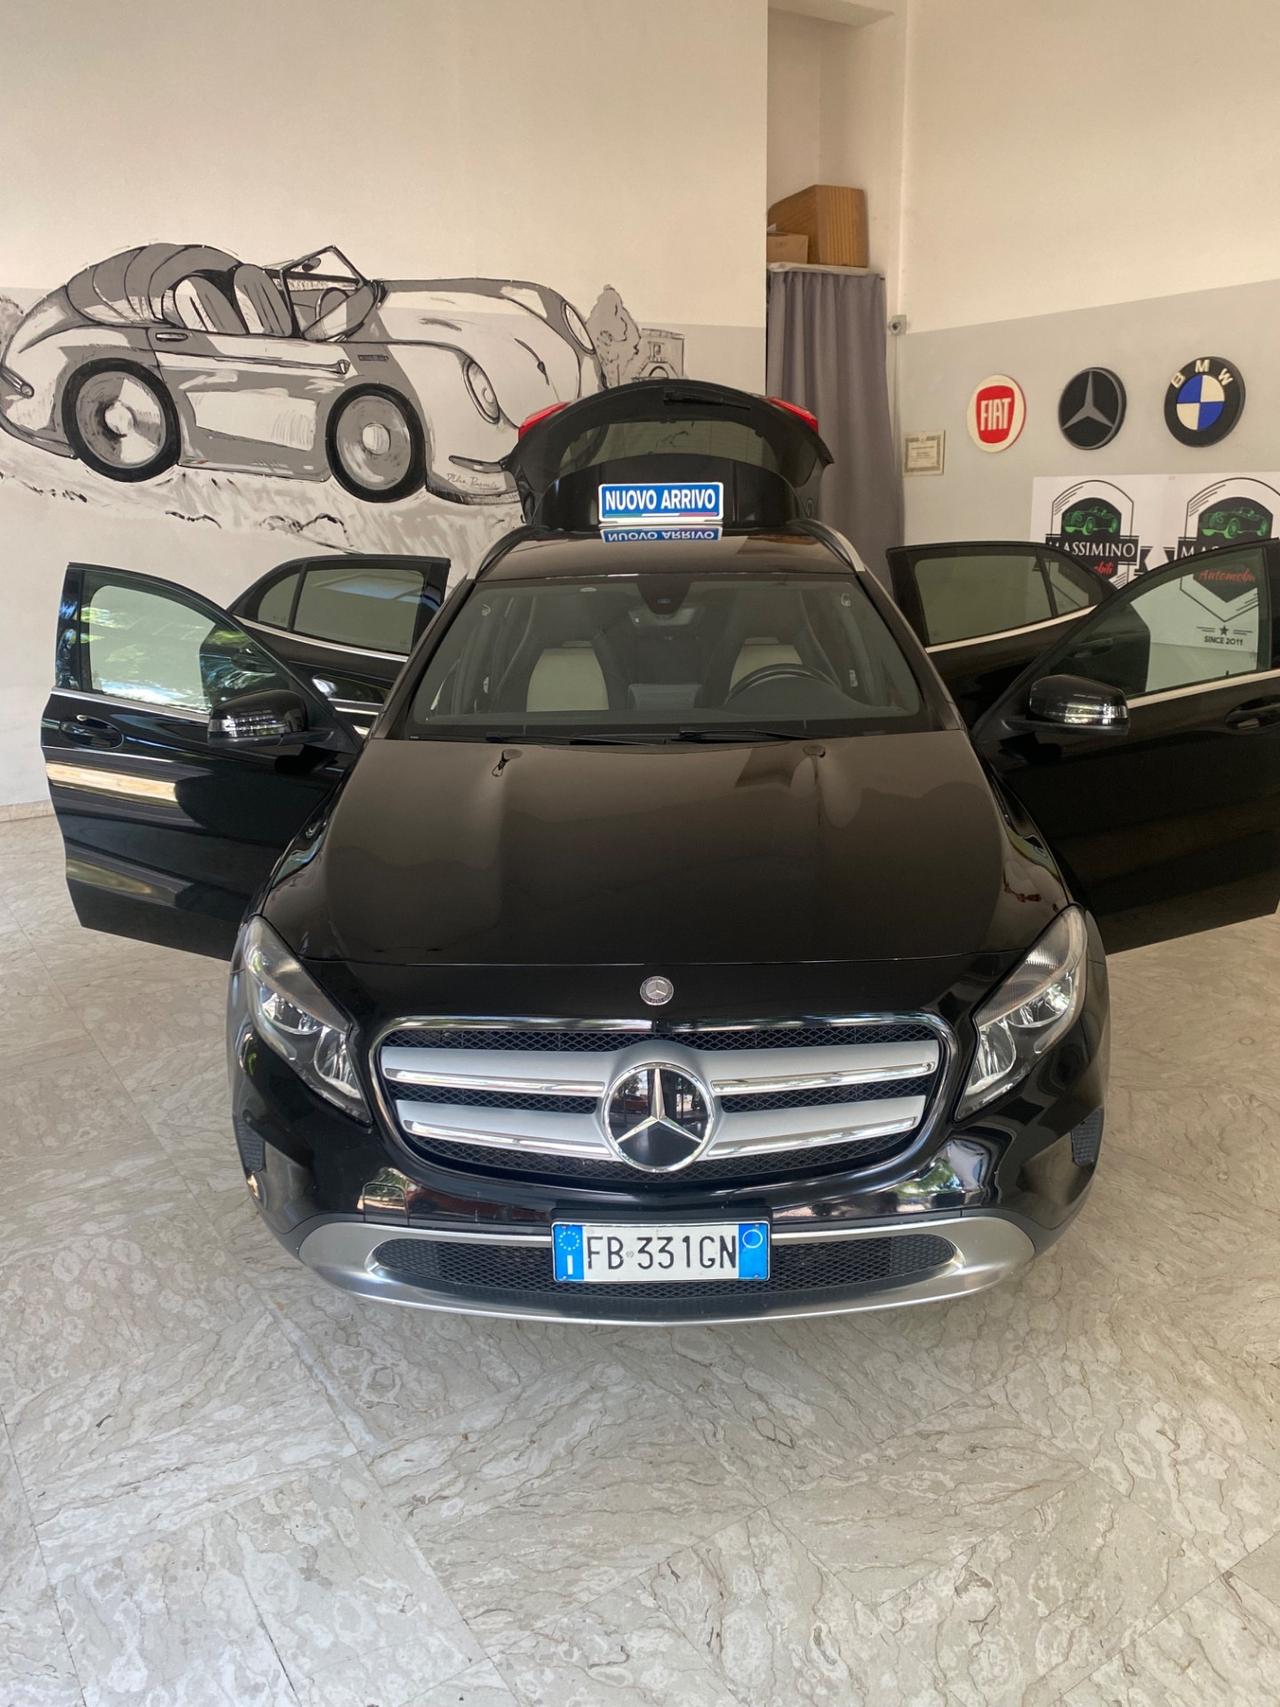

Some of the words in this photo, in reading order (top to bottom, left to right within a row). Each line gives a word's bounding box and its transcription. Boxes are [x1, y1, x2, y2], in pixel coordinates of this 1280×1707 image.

[1170, 359, 1233, 388] BMW
[980, 397, 1012, 431] FIAT
[605, 489, 657, 511] NUOVO
[661, 488, 716, 510] ARRIVO
[1204, 635, 1225, 645] SINCE
[1225, 638, 1243, 646] 2011
